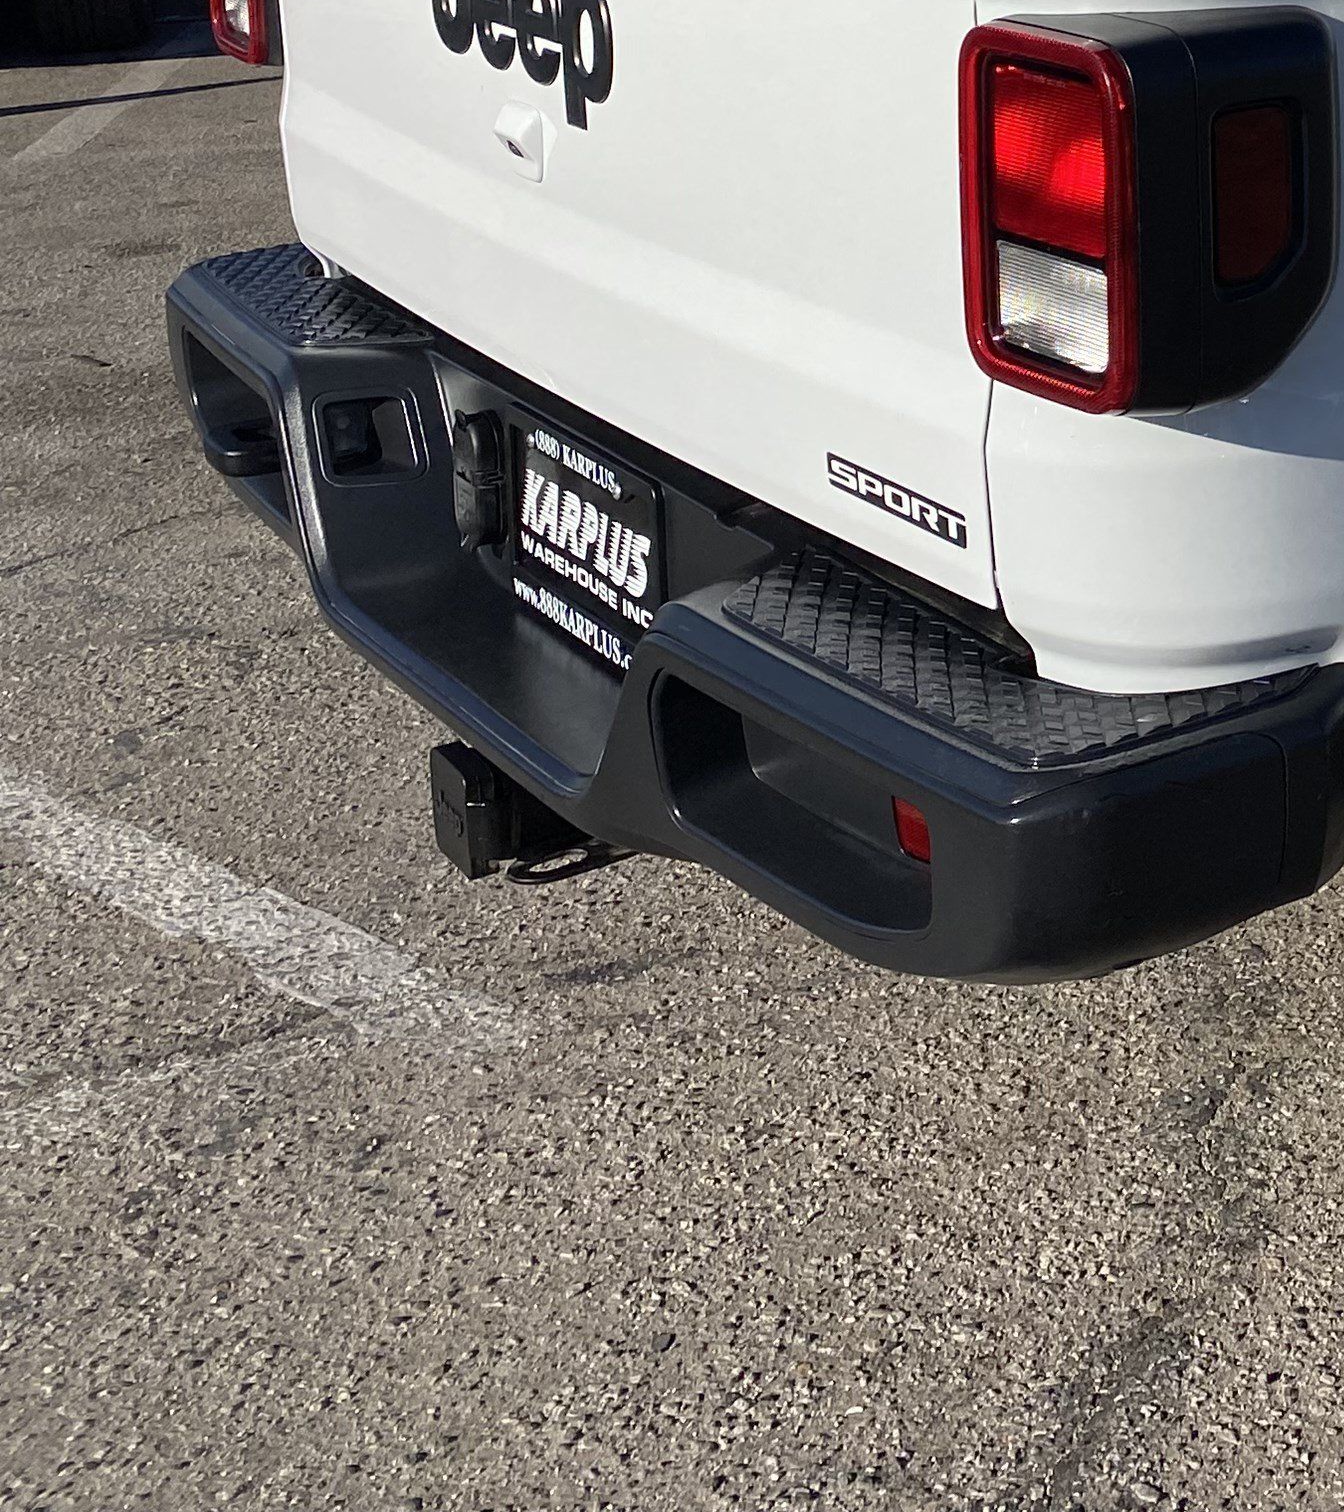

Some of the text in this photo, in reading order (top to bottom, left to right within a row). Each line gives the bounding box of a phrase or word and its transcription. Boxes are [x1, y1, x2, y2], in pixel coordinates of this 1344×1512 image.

[534, 428, 617, 492] (888) KARPLUS
[827, 457, 968, 542] SPORT
[519, 467, 652, 599] KARPLUS
[520, 530, 654, 630] WAREHOUSE INC
[513, 577, 634, 671] www.888KARPLUS.c
